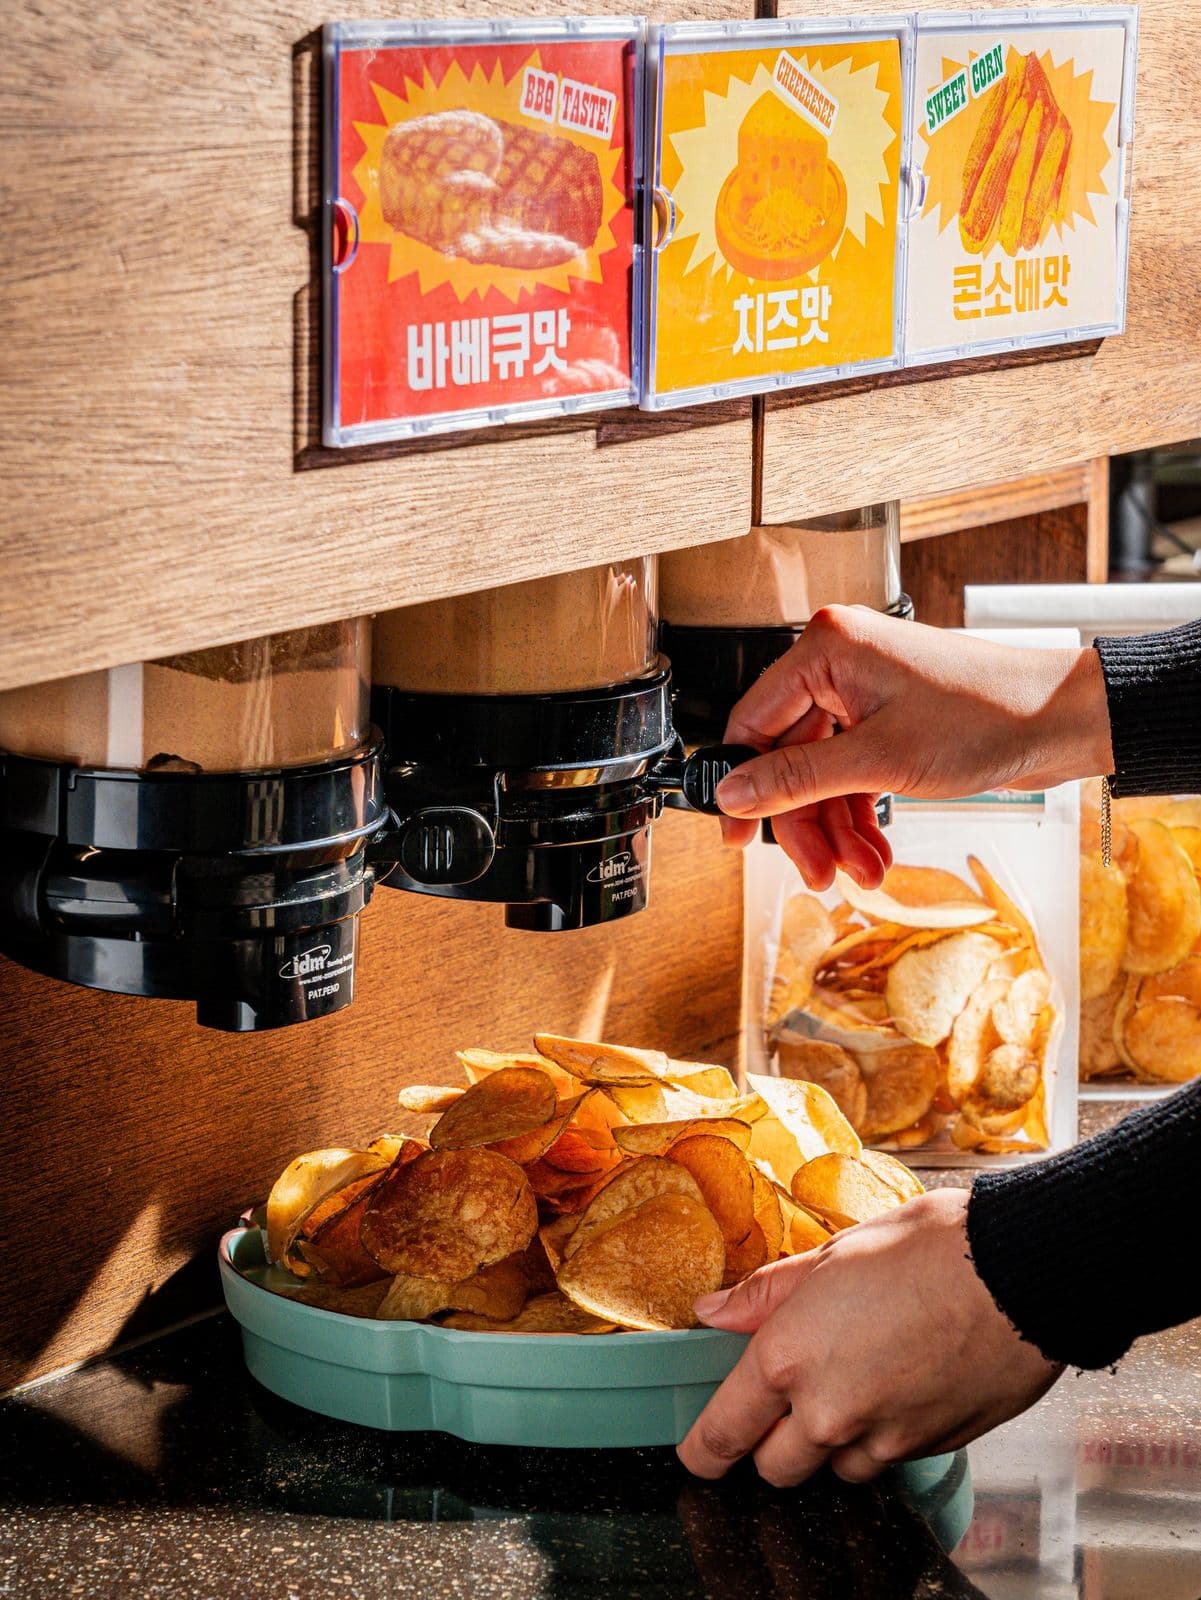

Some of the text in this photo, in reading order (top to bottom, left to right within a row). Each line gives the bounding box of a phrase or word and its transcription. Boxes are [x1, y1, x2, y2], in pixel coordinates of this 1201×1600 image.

[524, 74, 612, 133] BBQ TASTE!
[926, 44, 1003, 130] SWEET CORN
[732, 285, 832, 355] 치즈맛
[953, 255, 1071, 321] 콘소메맛
[407, 308, 571, 391] 바베큐맛
[599, 859, 625, 879] idm
[293, 954, 325, 975] idm
